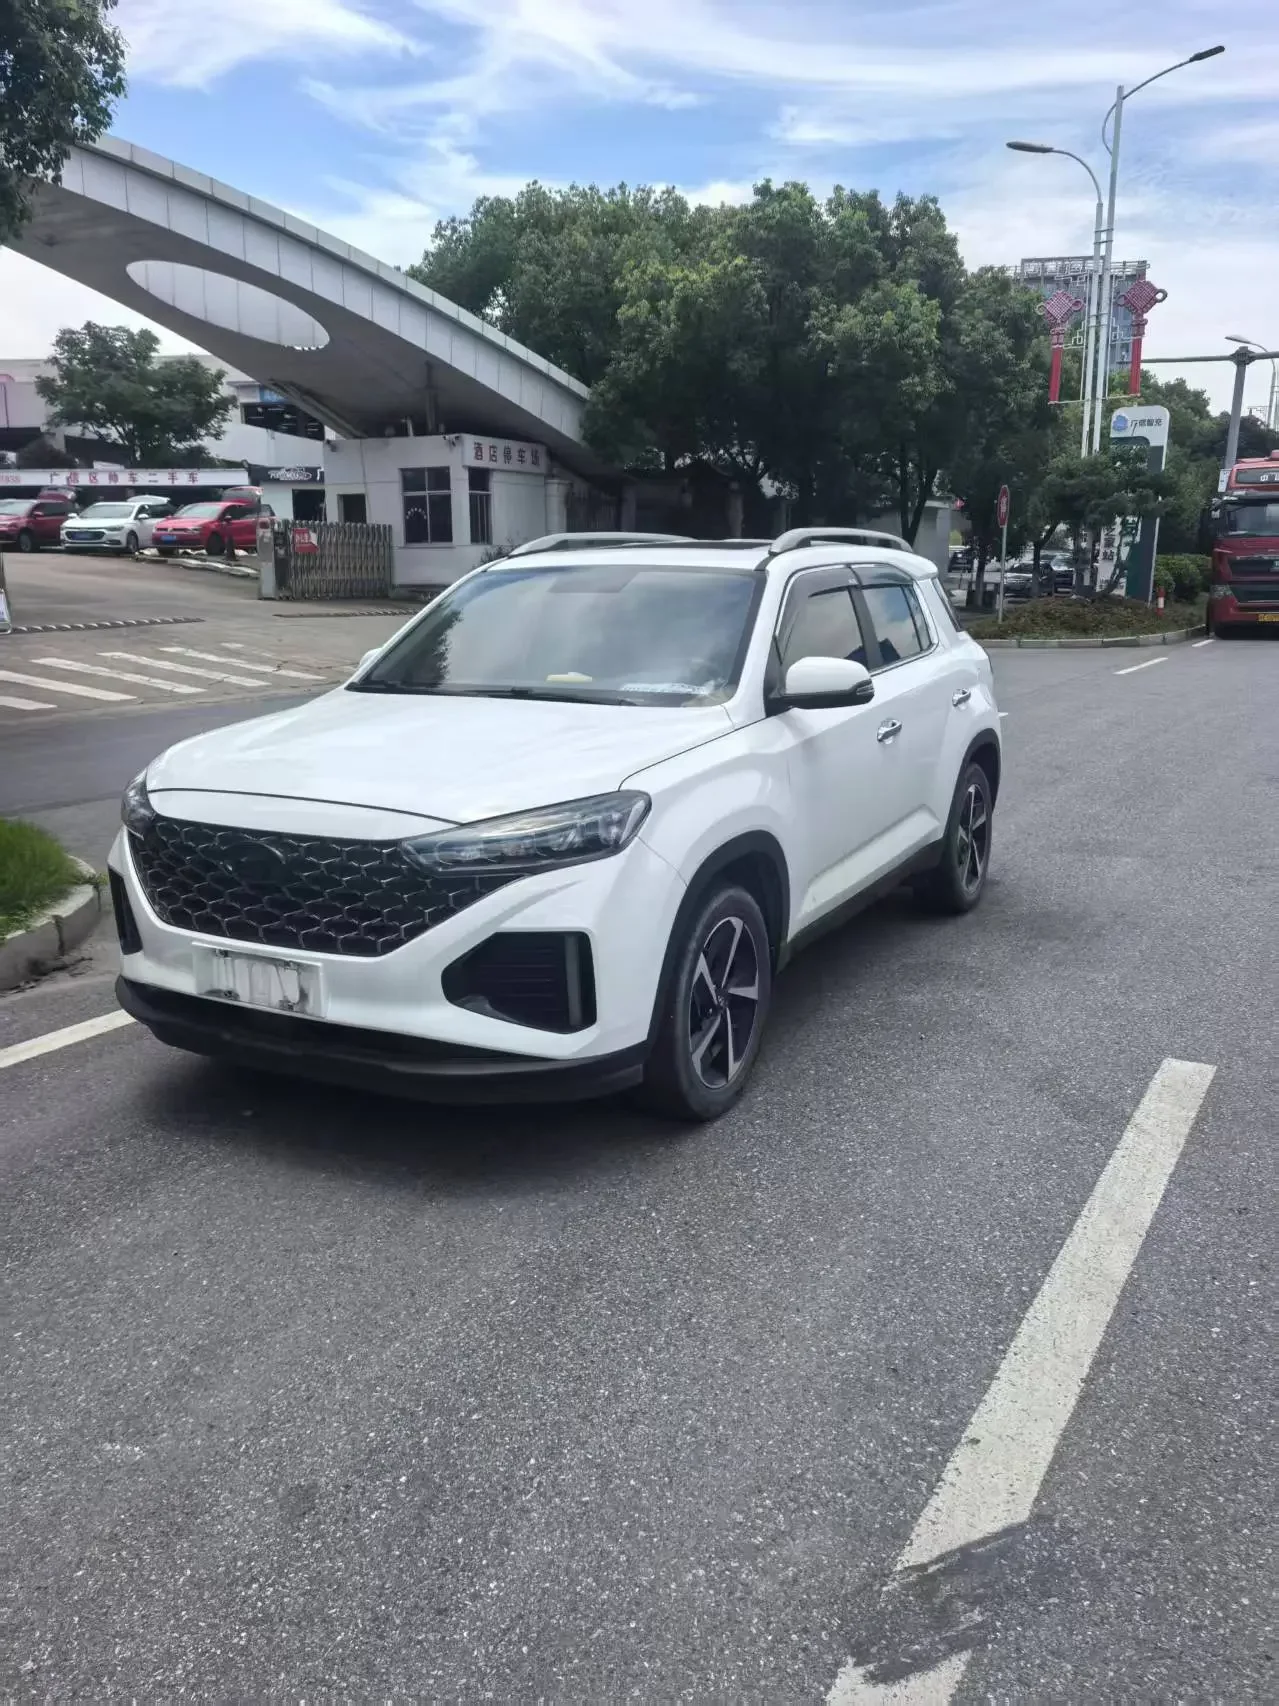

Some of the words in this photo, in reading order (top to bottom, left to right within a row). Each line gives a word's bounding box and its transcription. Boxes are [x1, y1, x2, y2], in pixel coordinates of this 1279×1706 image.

[474, 441, 541, 466] 酒店停车场
